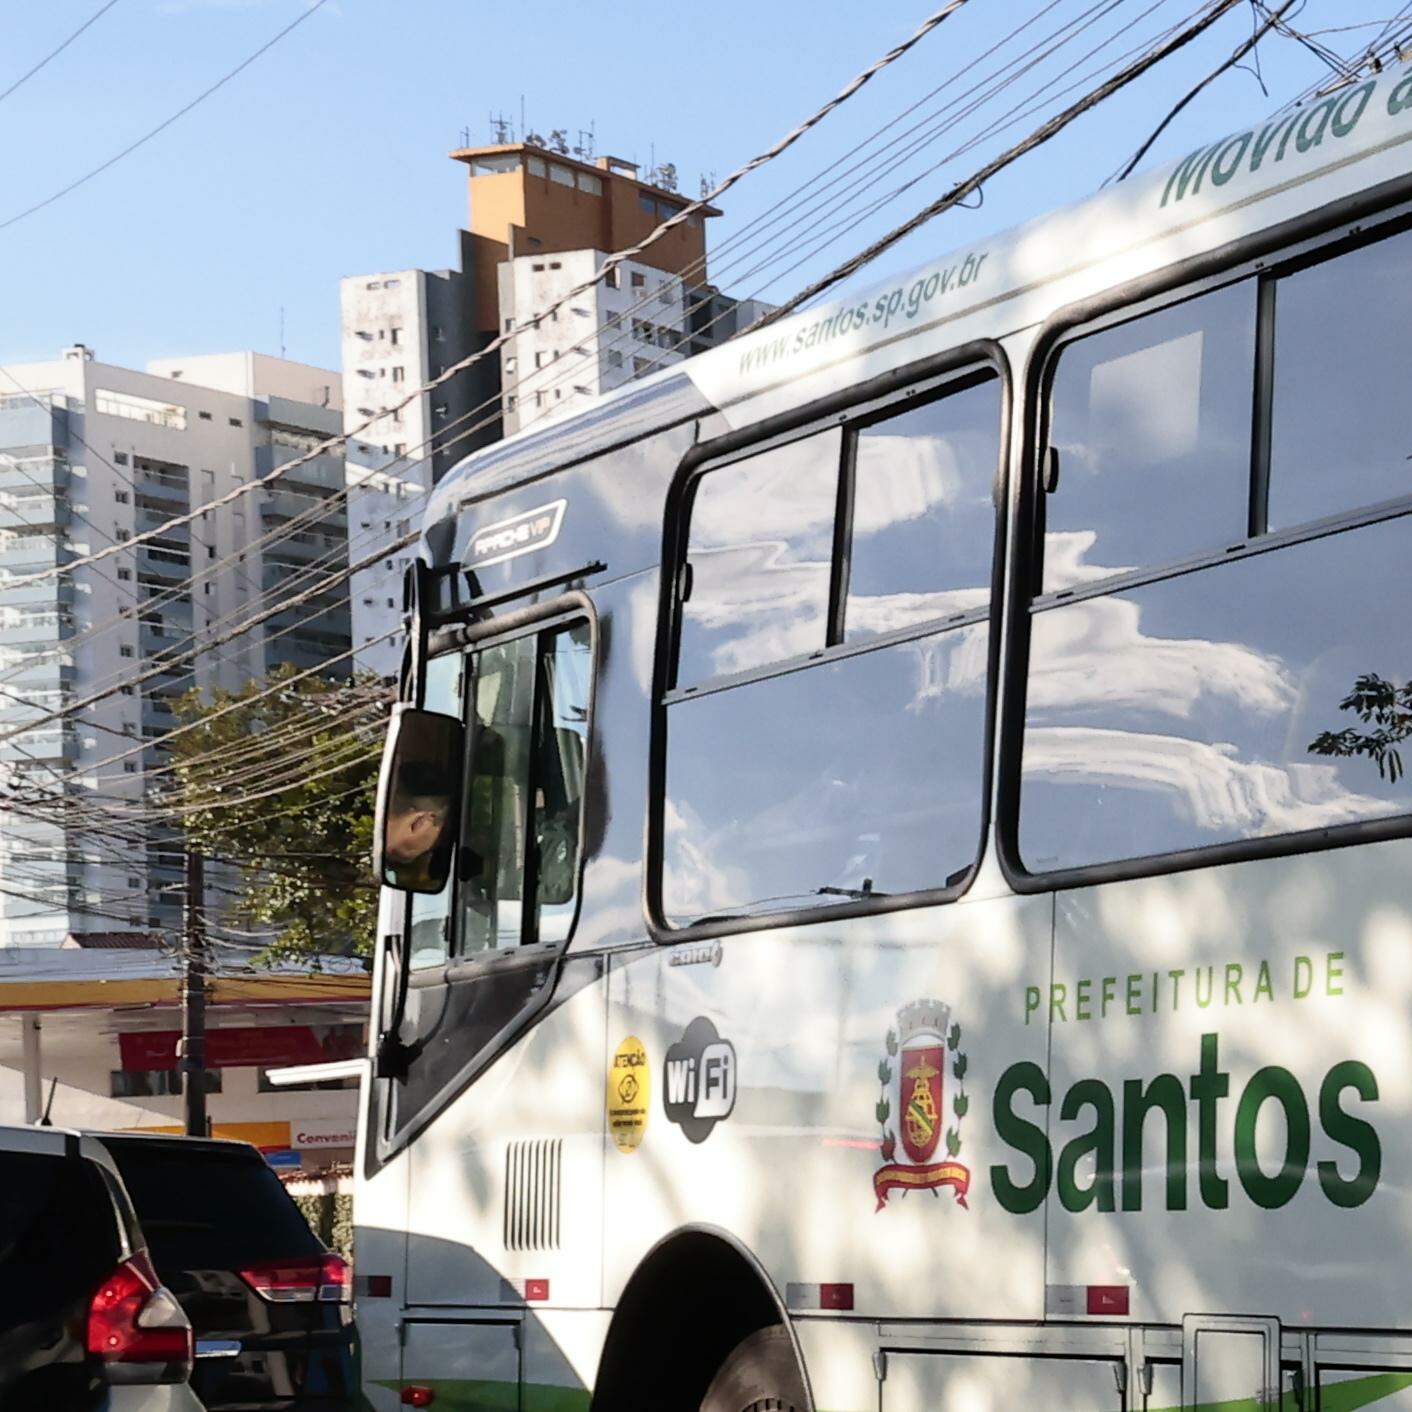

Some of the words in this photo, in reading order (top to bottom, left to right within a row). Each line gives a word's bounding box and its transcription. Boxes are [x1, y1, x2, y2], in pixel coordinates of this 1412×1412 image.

[1159, 80, 1377, 208] Movido
[739, 252, 989, 375] www.santos.sp.gov.br
[1025, 960, 1275, 1026] PREFEITURA
[1293, 951, 1346, 1000] DE
[990, 1032, 1382, 1214] Santos
